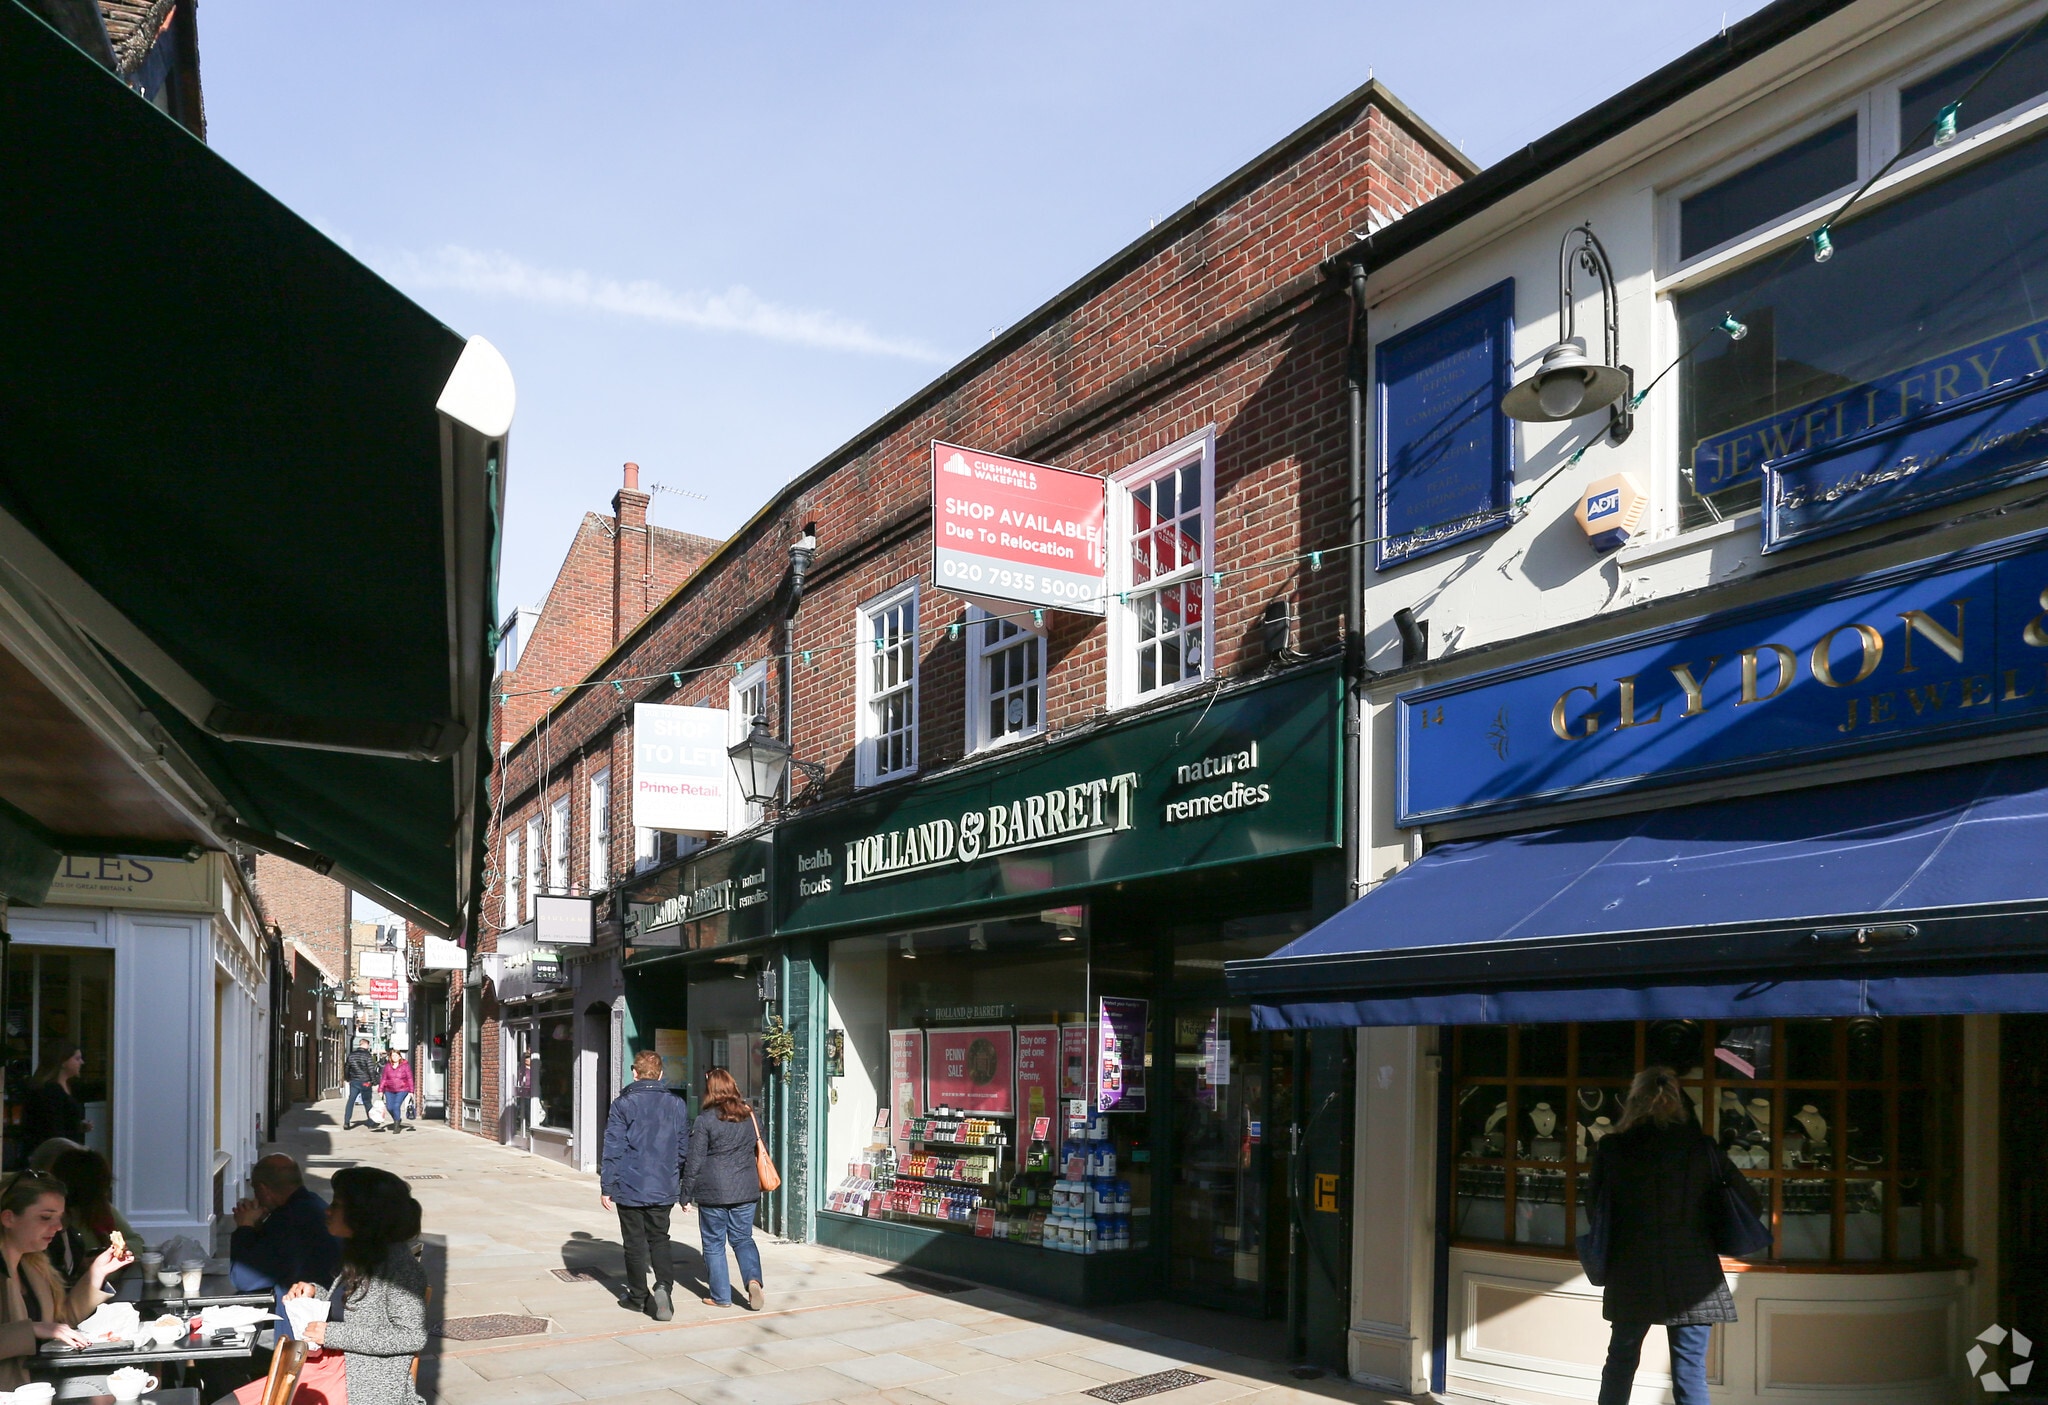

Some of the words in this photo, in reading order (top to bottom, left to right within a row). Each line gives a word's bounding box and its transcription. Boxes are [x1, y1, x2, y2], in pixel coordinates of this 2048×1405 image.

[1711, 345, 2006, 483] JEWELLERY
[974, 460, 1027, 480] CUSHMAN
[1029, 473, 1037, 482] &
[974, 469, 1037, 490] WAKEFIELD
[1588, 495, 1619, 517] ADT
[945, 497, 995, 520] SHOP
[999, 508, 1096, 541] AVAILABLE
[945, 522, 974, 540] Due
[978, 528, 997, 544] To
[1000, 532, 1074, 559] Relocation
[943, 559, 982, 581] 020
[988, 567, 1036, 591] 7935
[1040, 576, 1092, 601] 5000
[1550, 599, 1972, 742] GLYDON
[1837, 662, 2048, 733] JEWEL
[1422, 705, 1445, 729] 14
[654, 720, 711, 739] SHOP
[641, 743, 674, 764] TO
[680, 746, 721, 767] LET
[1177, 740, 1260, 785] natural
[639, 781, 679, 795] Prime
[1166, 781, 1271, 823] remedies
[844, 816, 955, 886] HOLLAND
[956, 812, 987, 863] &
[987, 772, 1141, 850] BARRETT
[798, 849, 832, 873] health
[742, 867, 766, 889] natural
[799, 875, 832, 897] foods
[739, 888, 769, 909] remedies
[638, 896, 678, 934] HOLLAND
[935, 1006, 966, 1020] HOLLAND
[965, 1005, 973, 1019] &
[974, 1005, 1004, 1018] BARRETT
[893, 1039, 903, 1048] Buy
[1021, 1035, 1033, 1047] Buy
[1034, 1036, 1047, 1044] one
[893, 1050, 903, 1059] get
[945, 1048, 966, 1060] PENNY
[1020, 1048, 1031, 1059] get
[1032, 1049, 1045, 1057] one
[1020, 1060, 1030, 1068] for
[947, 1065, 964, 1077] SALE
[1019, 1071, 1041, 1083] Penny.
